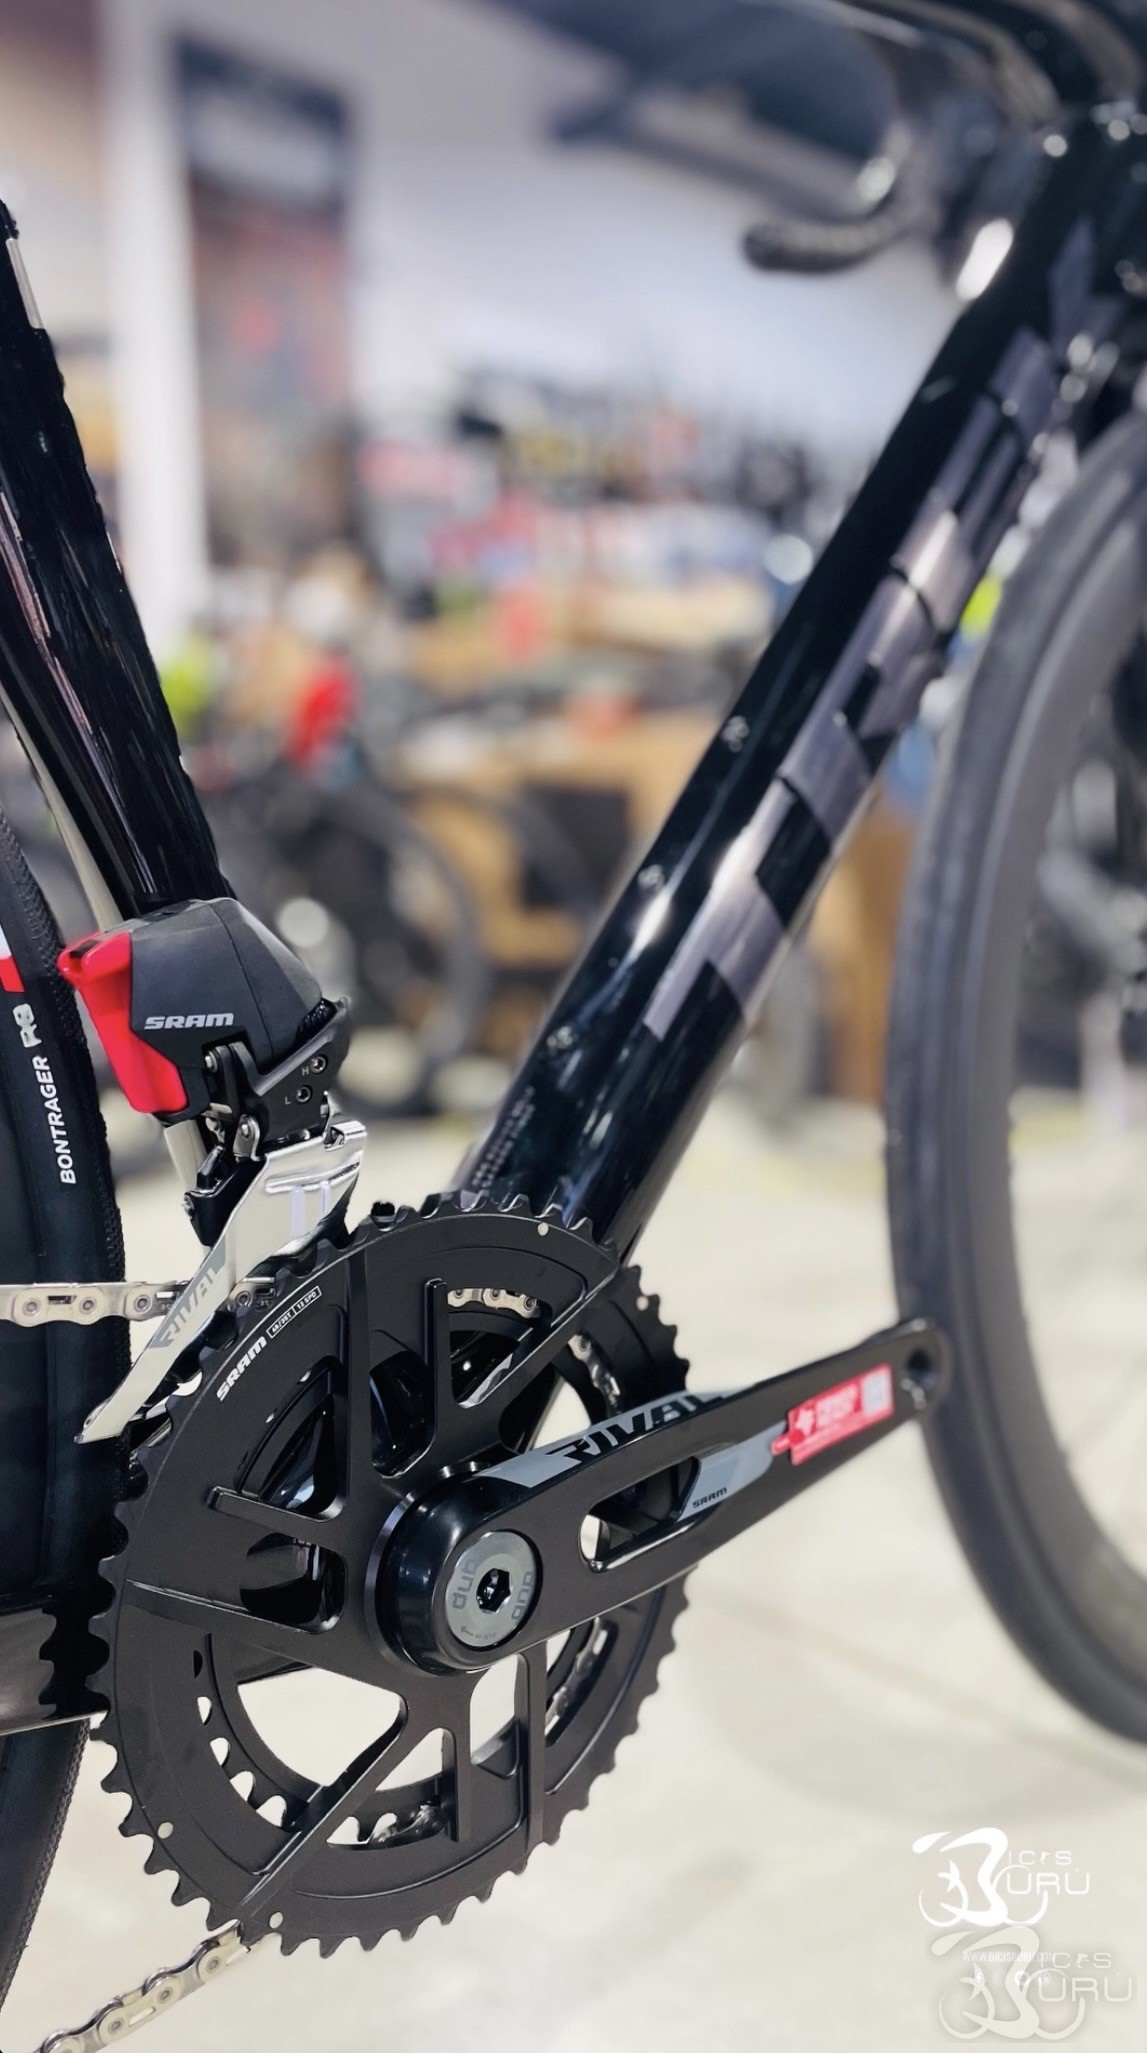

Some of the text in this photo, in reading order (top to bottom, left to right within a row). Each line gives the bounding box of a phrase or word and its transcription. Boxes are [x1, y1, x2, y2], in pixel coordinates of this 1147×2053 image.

[144, 1012, 234, 1030] SRAM
[302, 1066, 309, 1075] H
[32, 1056, 77, 1185] BONTRAGER
[285, 1097, 291, 1105] L
[159, 1267, 225, 1347] RIVAL
[216, 1336, 268, 1401] SRAM
[546, 1394, 726, 1462] RIVAL
[692, 1486, 728, 1508] SRAM
